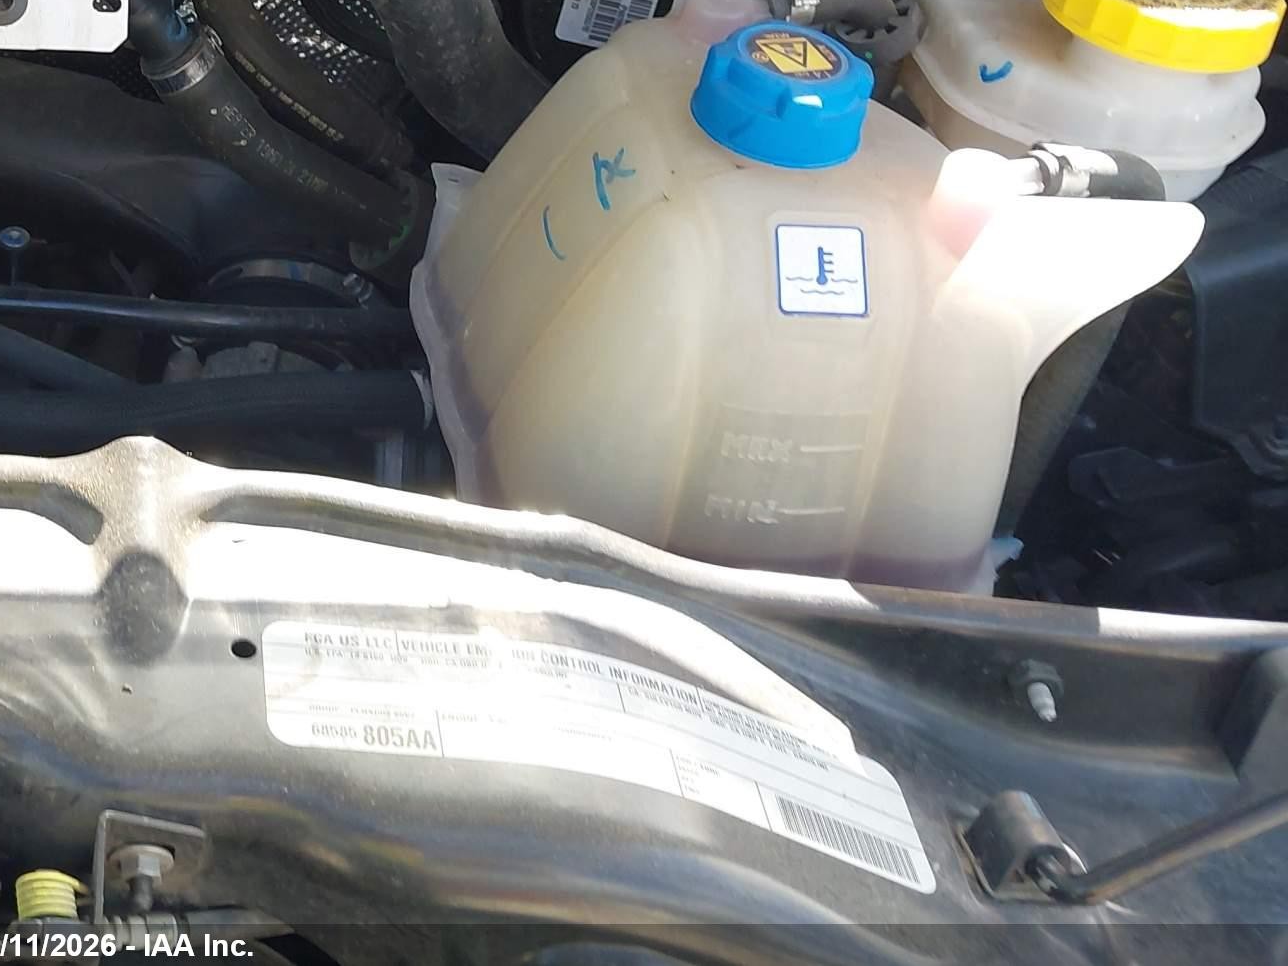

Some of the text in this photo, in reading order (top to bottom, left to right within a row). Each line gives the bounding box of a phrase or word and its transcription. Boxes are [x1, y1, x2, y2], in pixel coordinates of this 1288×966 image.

[339, 634, 360, 646] US
[400, 639, 461, 654] VEHICLE
[540, 650, 603, 675] CONTROL
[608, 666, 698, 705] INFORMATION
[363, 724, 438, 751] 805AA
